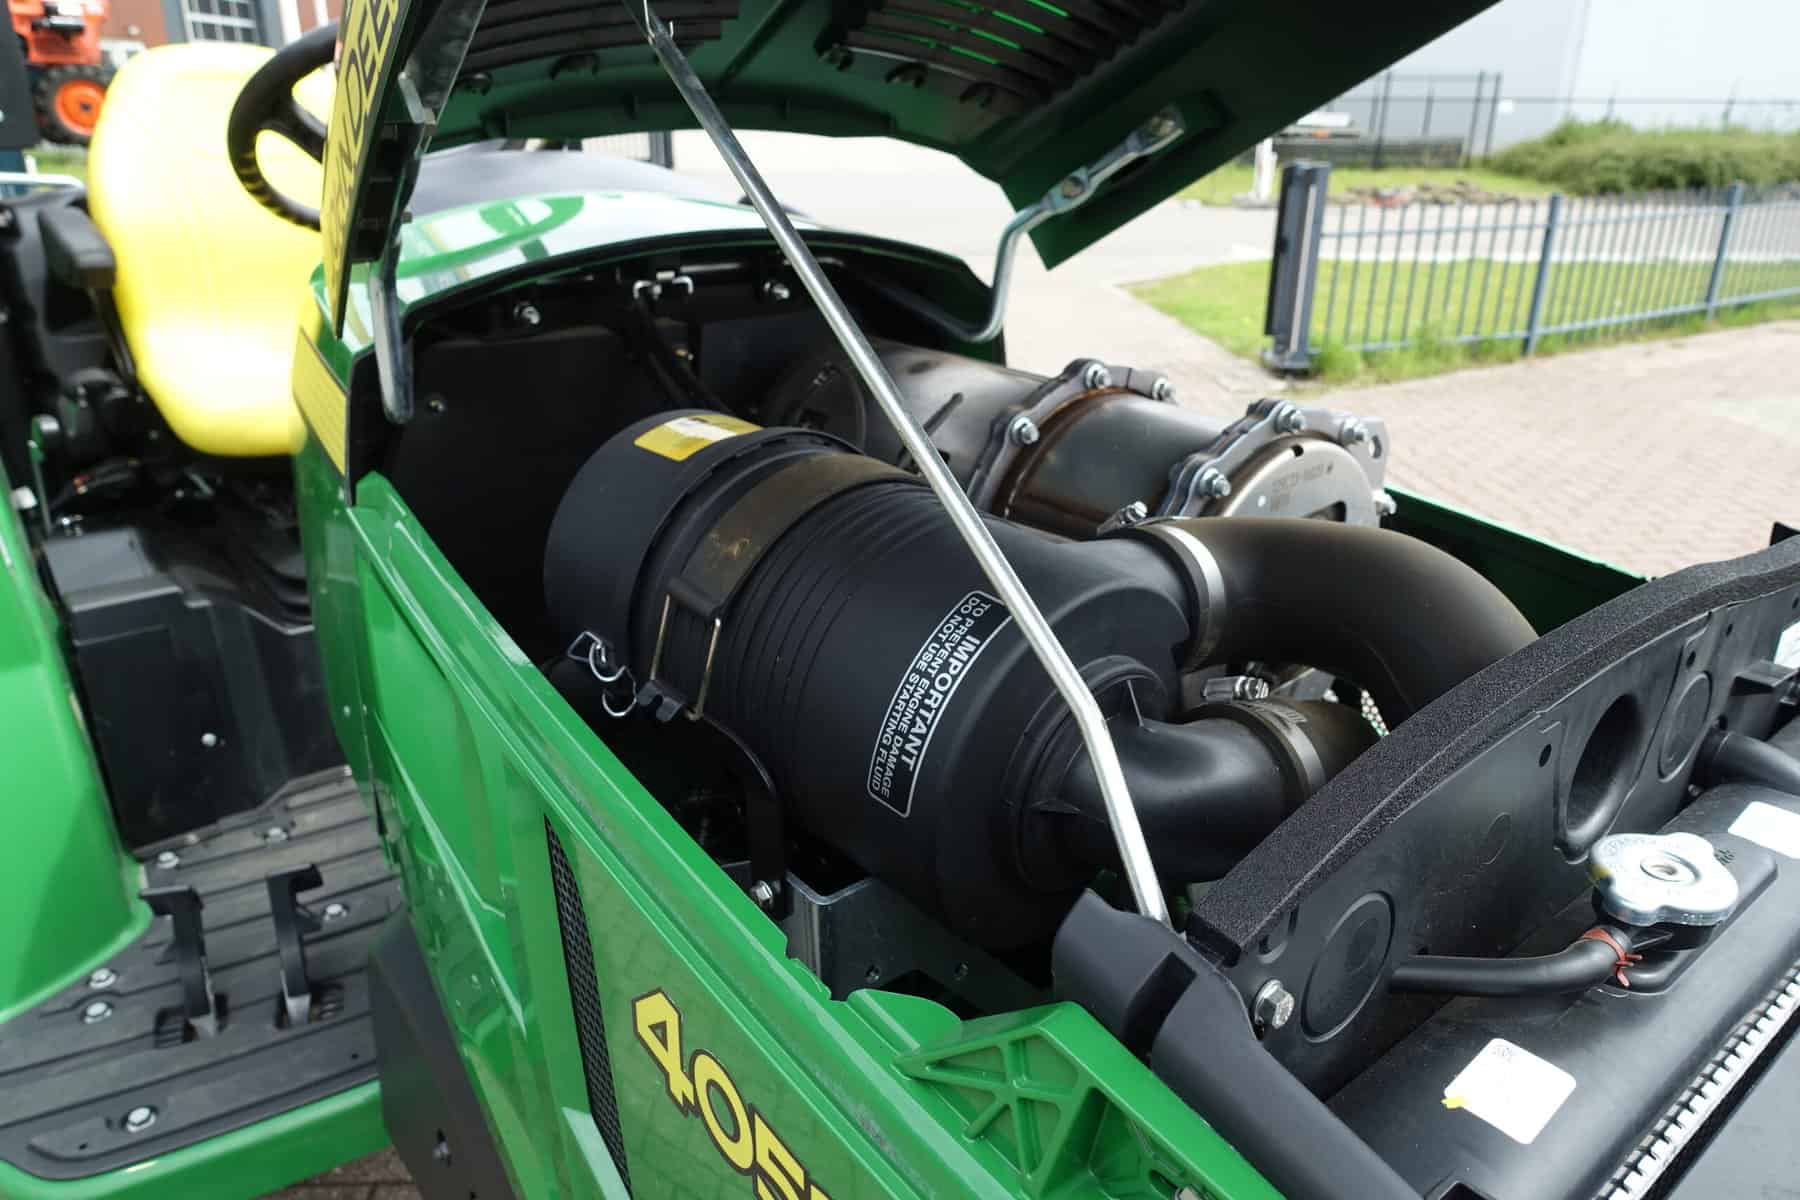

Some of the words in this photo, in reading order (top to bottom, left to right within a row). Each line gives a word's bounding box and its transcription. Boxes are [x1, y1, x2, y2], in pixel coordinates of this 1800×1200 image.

[937, 614, 963, 642] NOT
[960, 597, 980, 614] DO
[972, 603, 992, 617] TO
[915, 642, 941, 673] USE
[927, 617, 975, 678] PREVENT
[882, 672, 921, 746] STARTING
[898, 678, 931, 734] ENGINE
[901, 635, 981, 772] IMPORTANT
[872, 748, 889, 791] FLUID
[881, 735, 904, 798] DAMAGE
[632, 988, 832, 1200] 405
